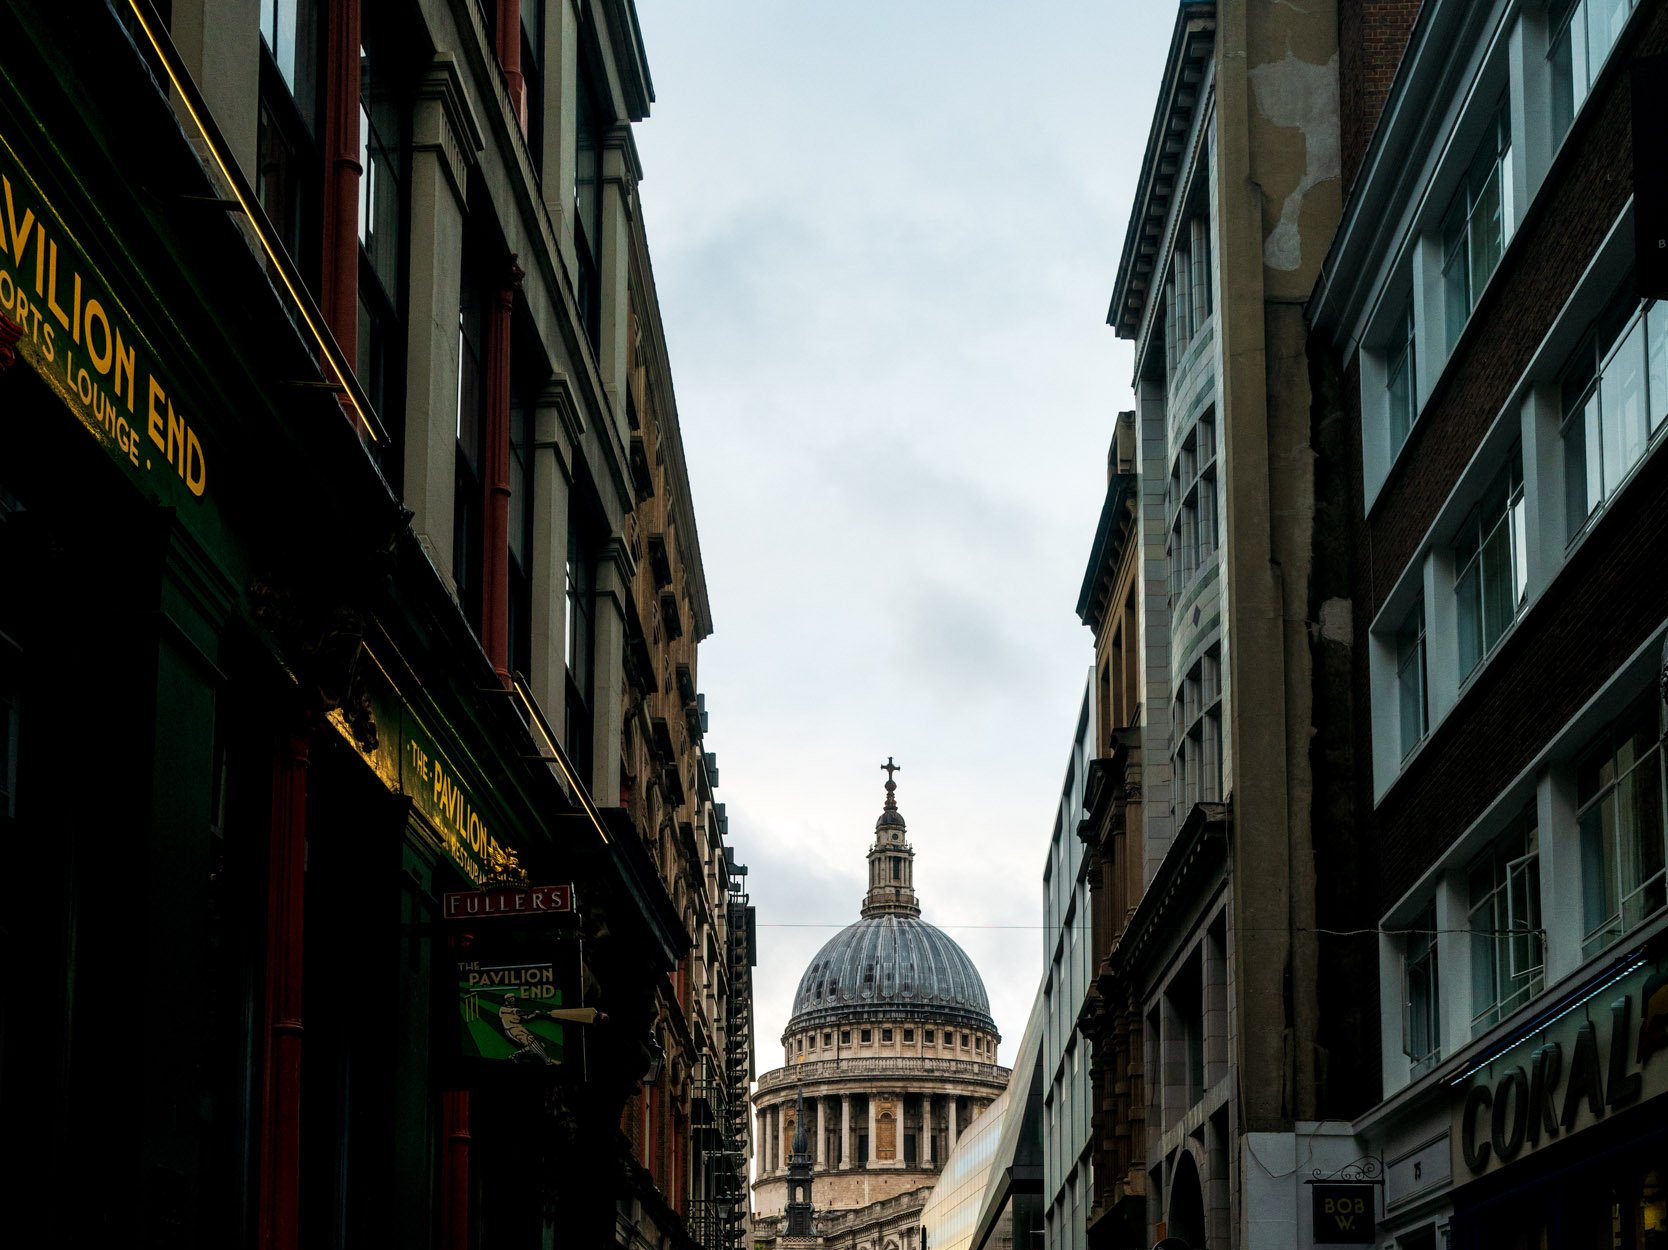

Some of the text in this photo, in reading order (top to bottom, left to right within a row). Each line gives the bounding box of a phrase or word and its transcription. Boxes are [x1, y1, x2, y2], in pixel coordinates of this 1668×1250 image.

[66, 350, 140, 468] LOUNGE
[147, 372, 206, 497] END
[411, 739, 487, 859] THE PAVILION
[450, 889, 562, 914] FULLER'S
[457, 961, 480, 971] THE
[469, 968, 553, 985] PAVILION
[520, 985, 555, 999] END
[1462, 995, 1642, 1174] CORAL
[1324, 1198, 1365, 1214] BOB
